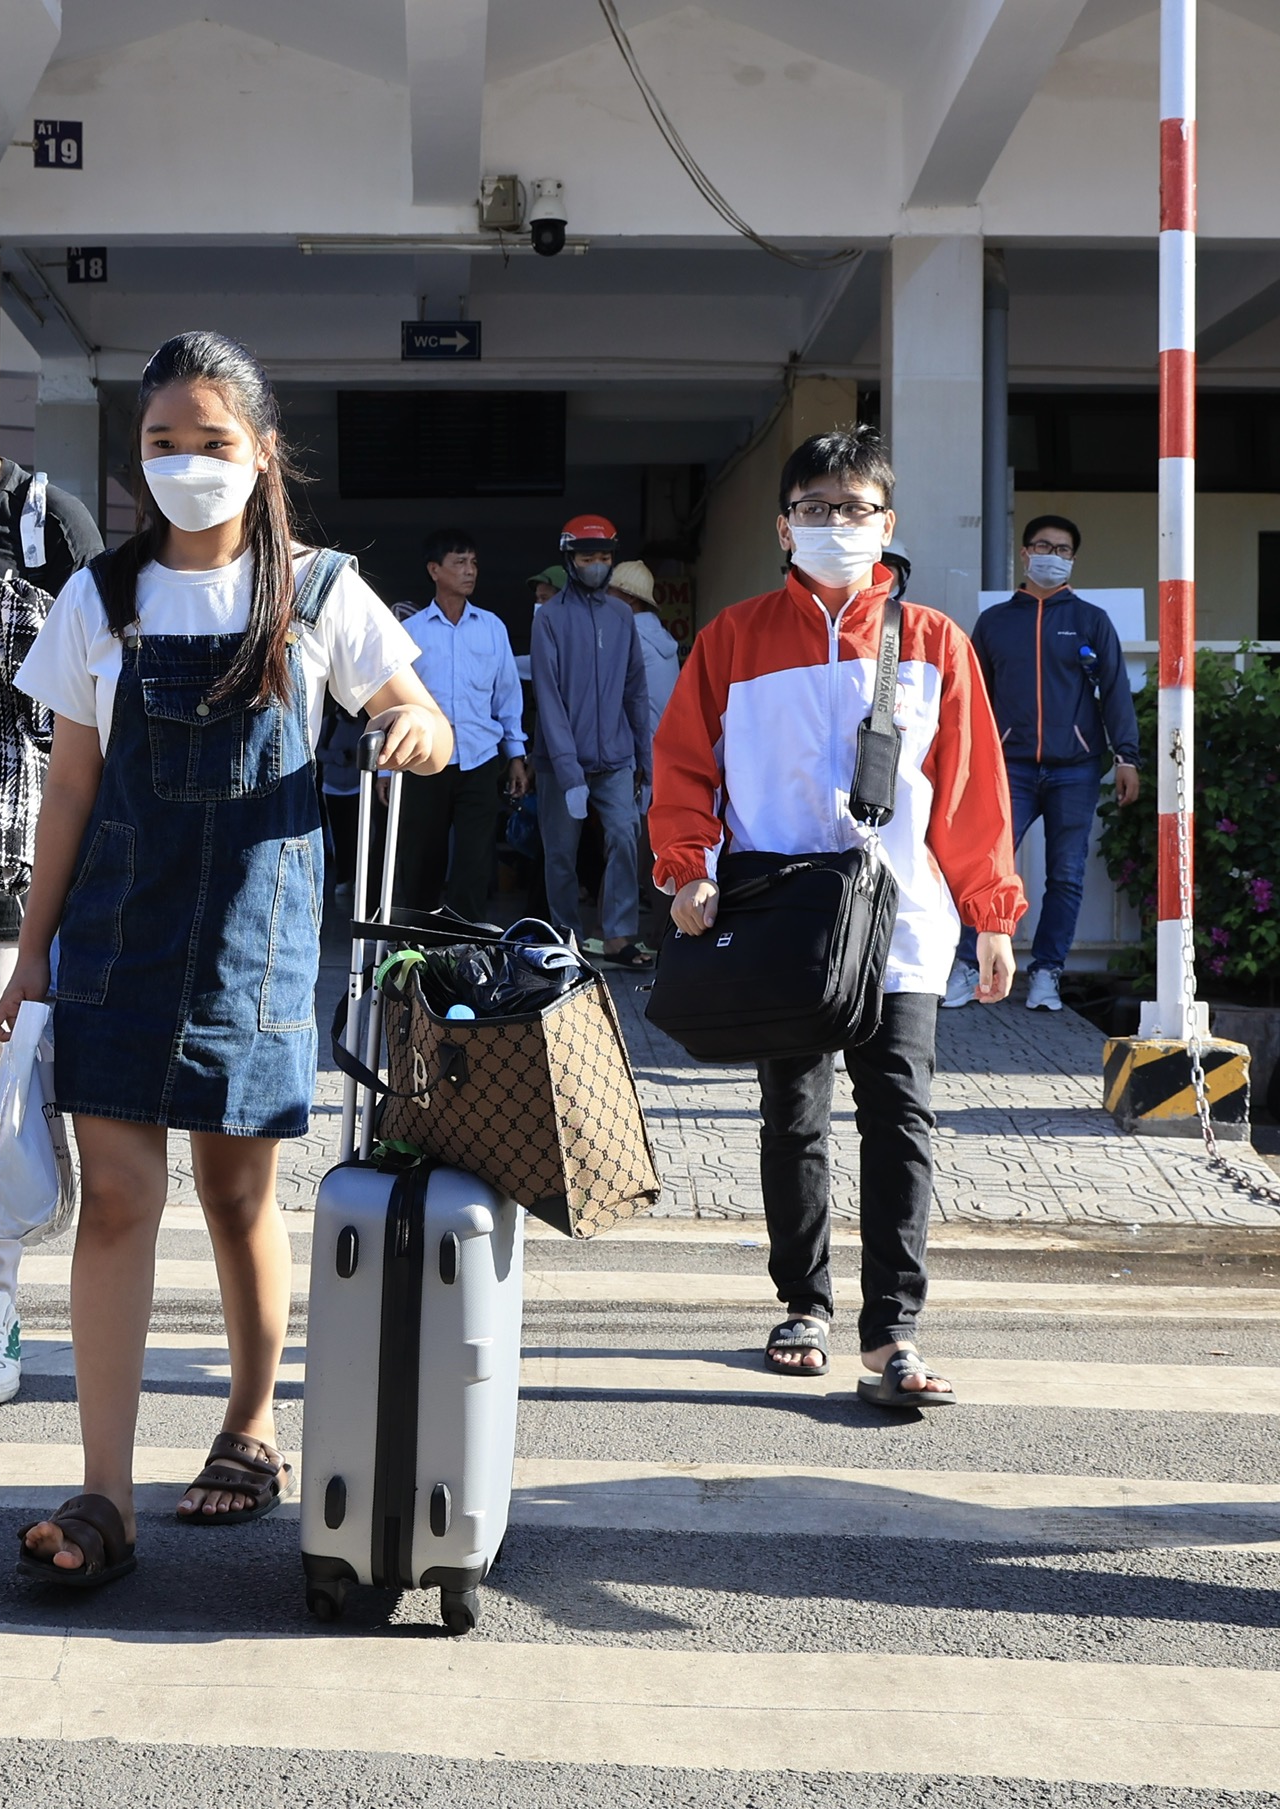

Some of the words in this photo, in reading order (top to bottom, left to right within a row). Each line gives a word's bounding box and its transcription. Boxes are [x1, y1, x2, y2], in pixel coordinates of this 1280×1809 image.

[37, 123, 52, 135] A1
[44, 138, 78, 164] 19
[75, 257, 103, 279] 18
[414, 335, 438, 348] WC
